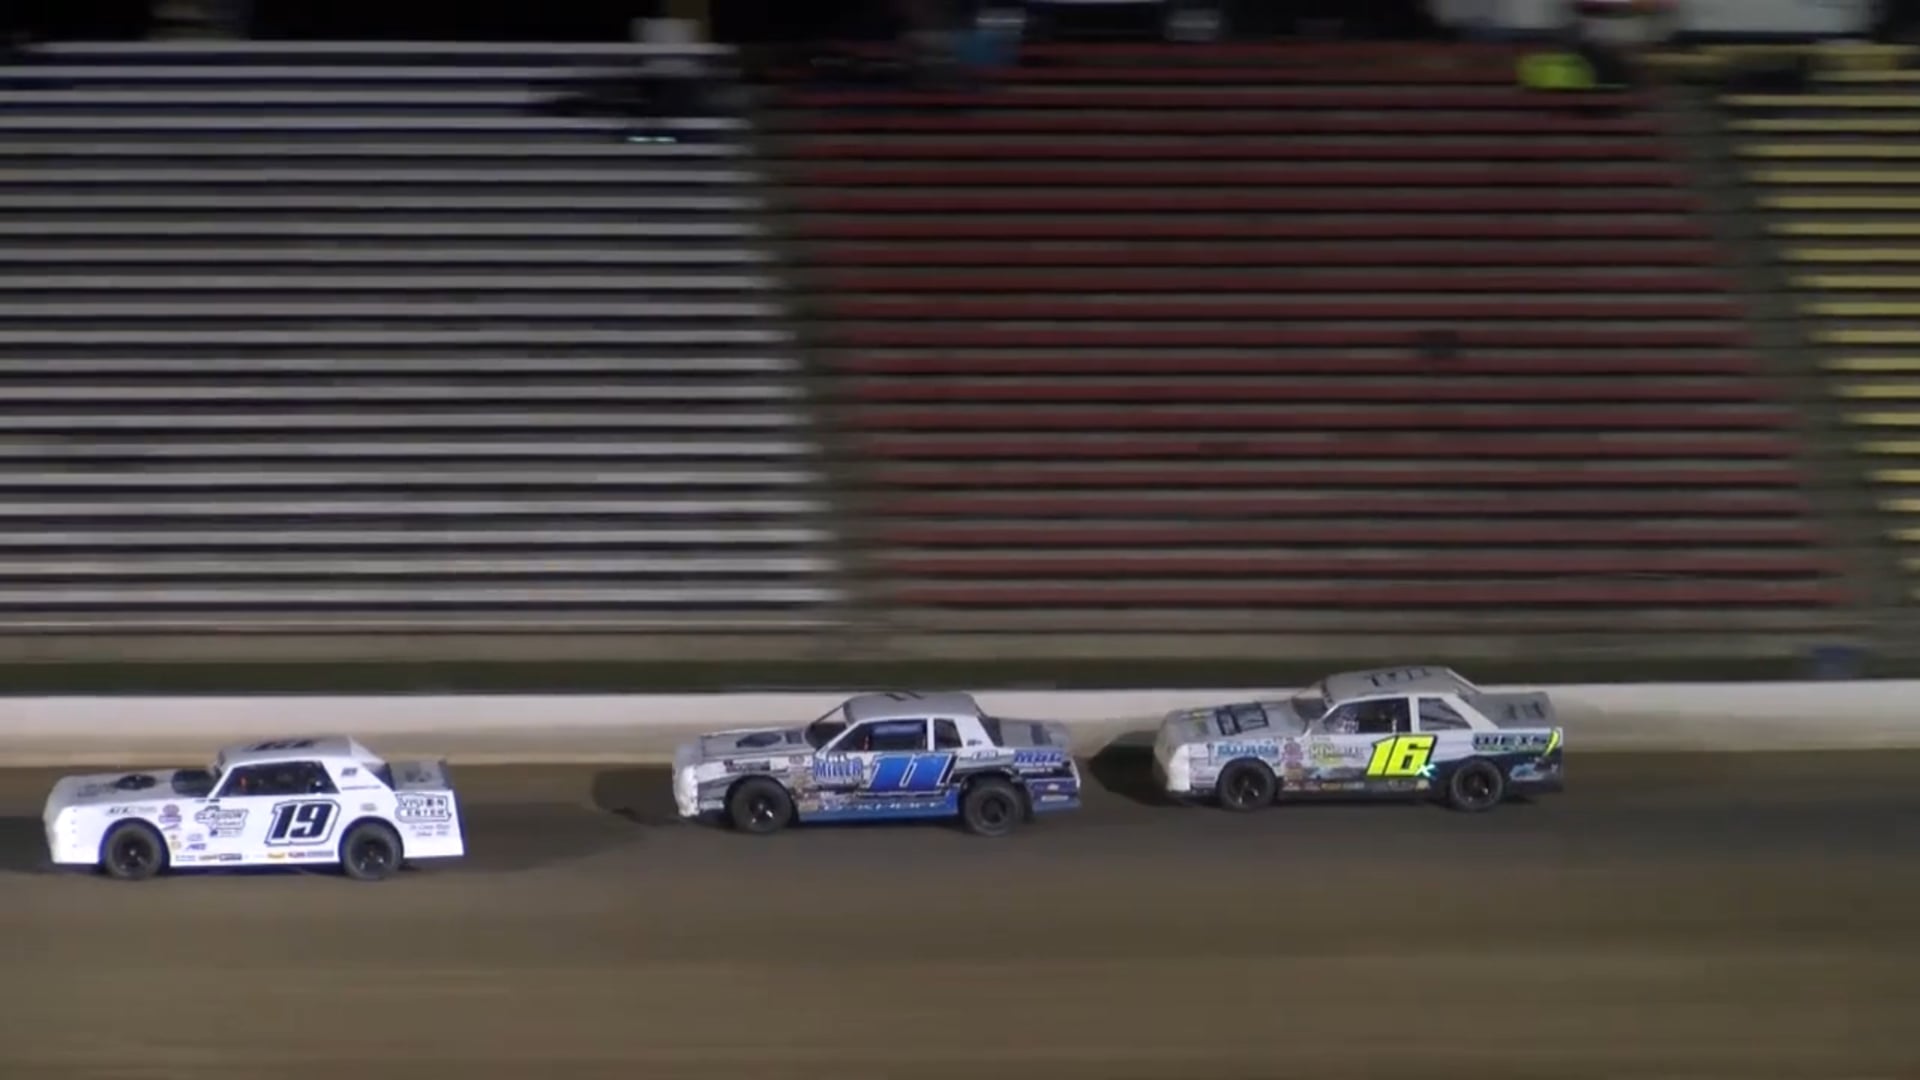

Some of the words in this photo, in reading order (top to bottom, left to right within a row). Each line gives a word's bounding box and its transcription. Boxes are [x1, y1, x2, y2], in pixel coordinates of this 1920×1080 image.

[868, 752, 951, 789] 11
[1366, 734, 1437, 778] 16
[266, 800, 338, 844] 19
